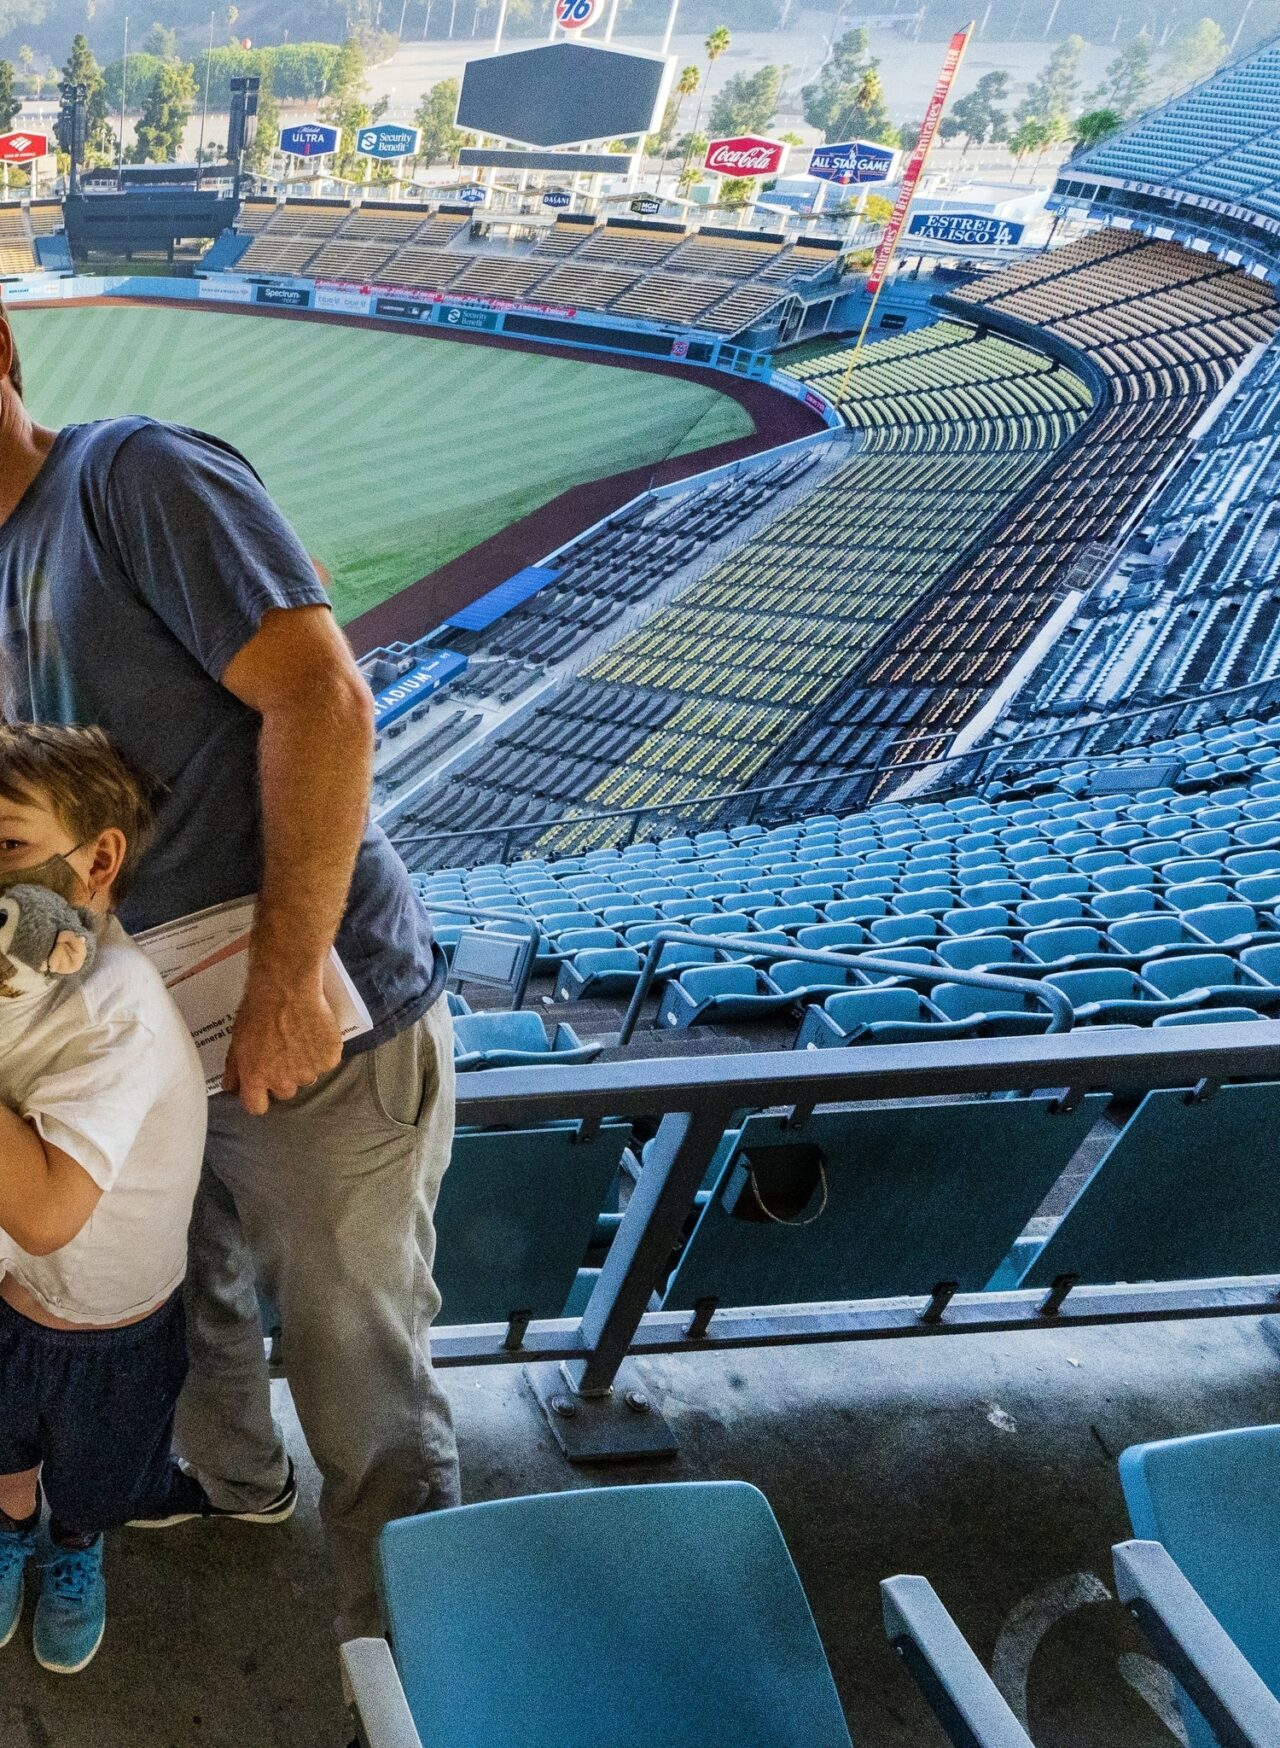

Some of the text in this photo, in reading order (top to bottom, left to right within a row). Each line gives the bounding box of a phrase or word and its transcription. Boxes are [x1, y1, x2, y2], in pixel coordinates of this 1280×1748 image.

[561, 0, 591, 20] 76
[912, 103, 941, 160] Emirates
[292, 133, 325, 143] ULTRA
[379, 132, 412, 143] Security
[378, 142, 406, 152] Benefit
[811, 156, 890, 172] ALL STAR GAME
[544, 195, 569, 205] DASANI
[914, 226, 989, 244] JALISCO
[870, 226, 897, 281] Emirates
[265, 288, 299, 298] Spectrum
[463, 311, 487, 321] Security
[461, 317, 483, 327] Benefit
[195, 1029, 226, 1048] General
